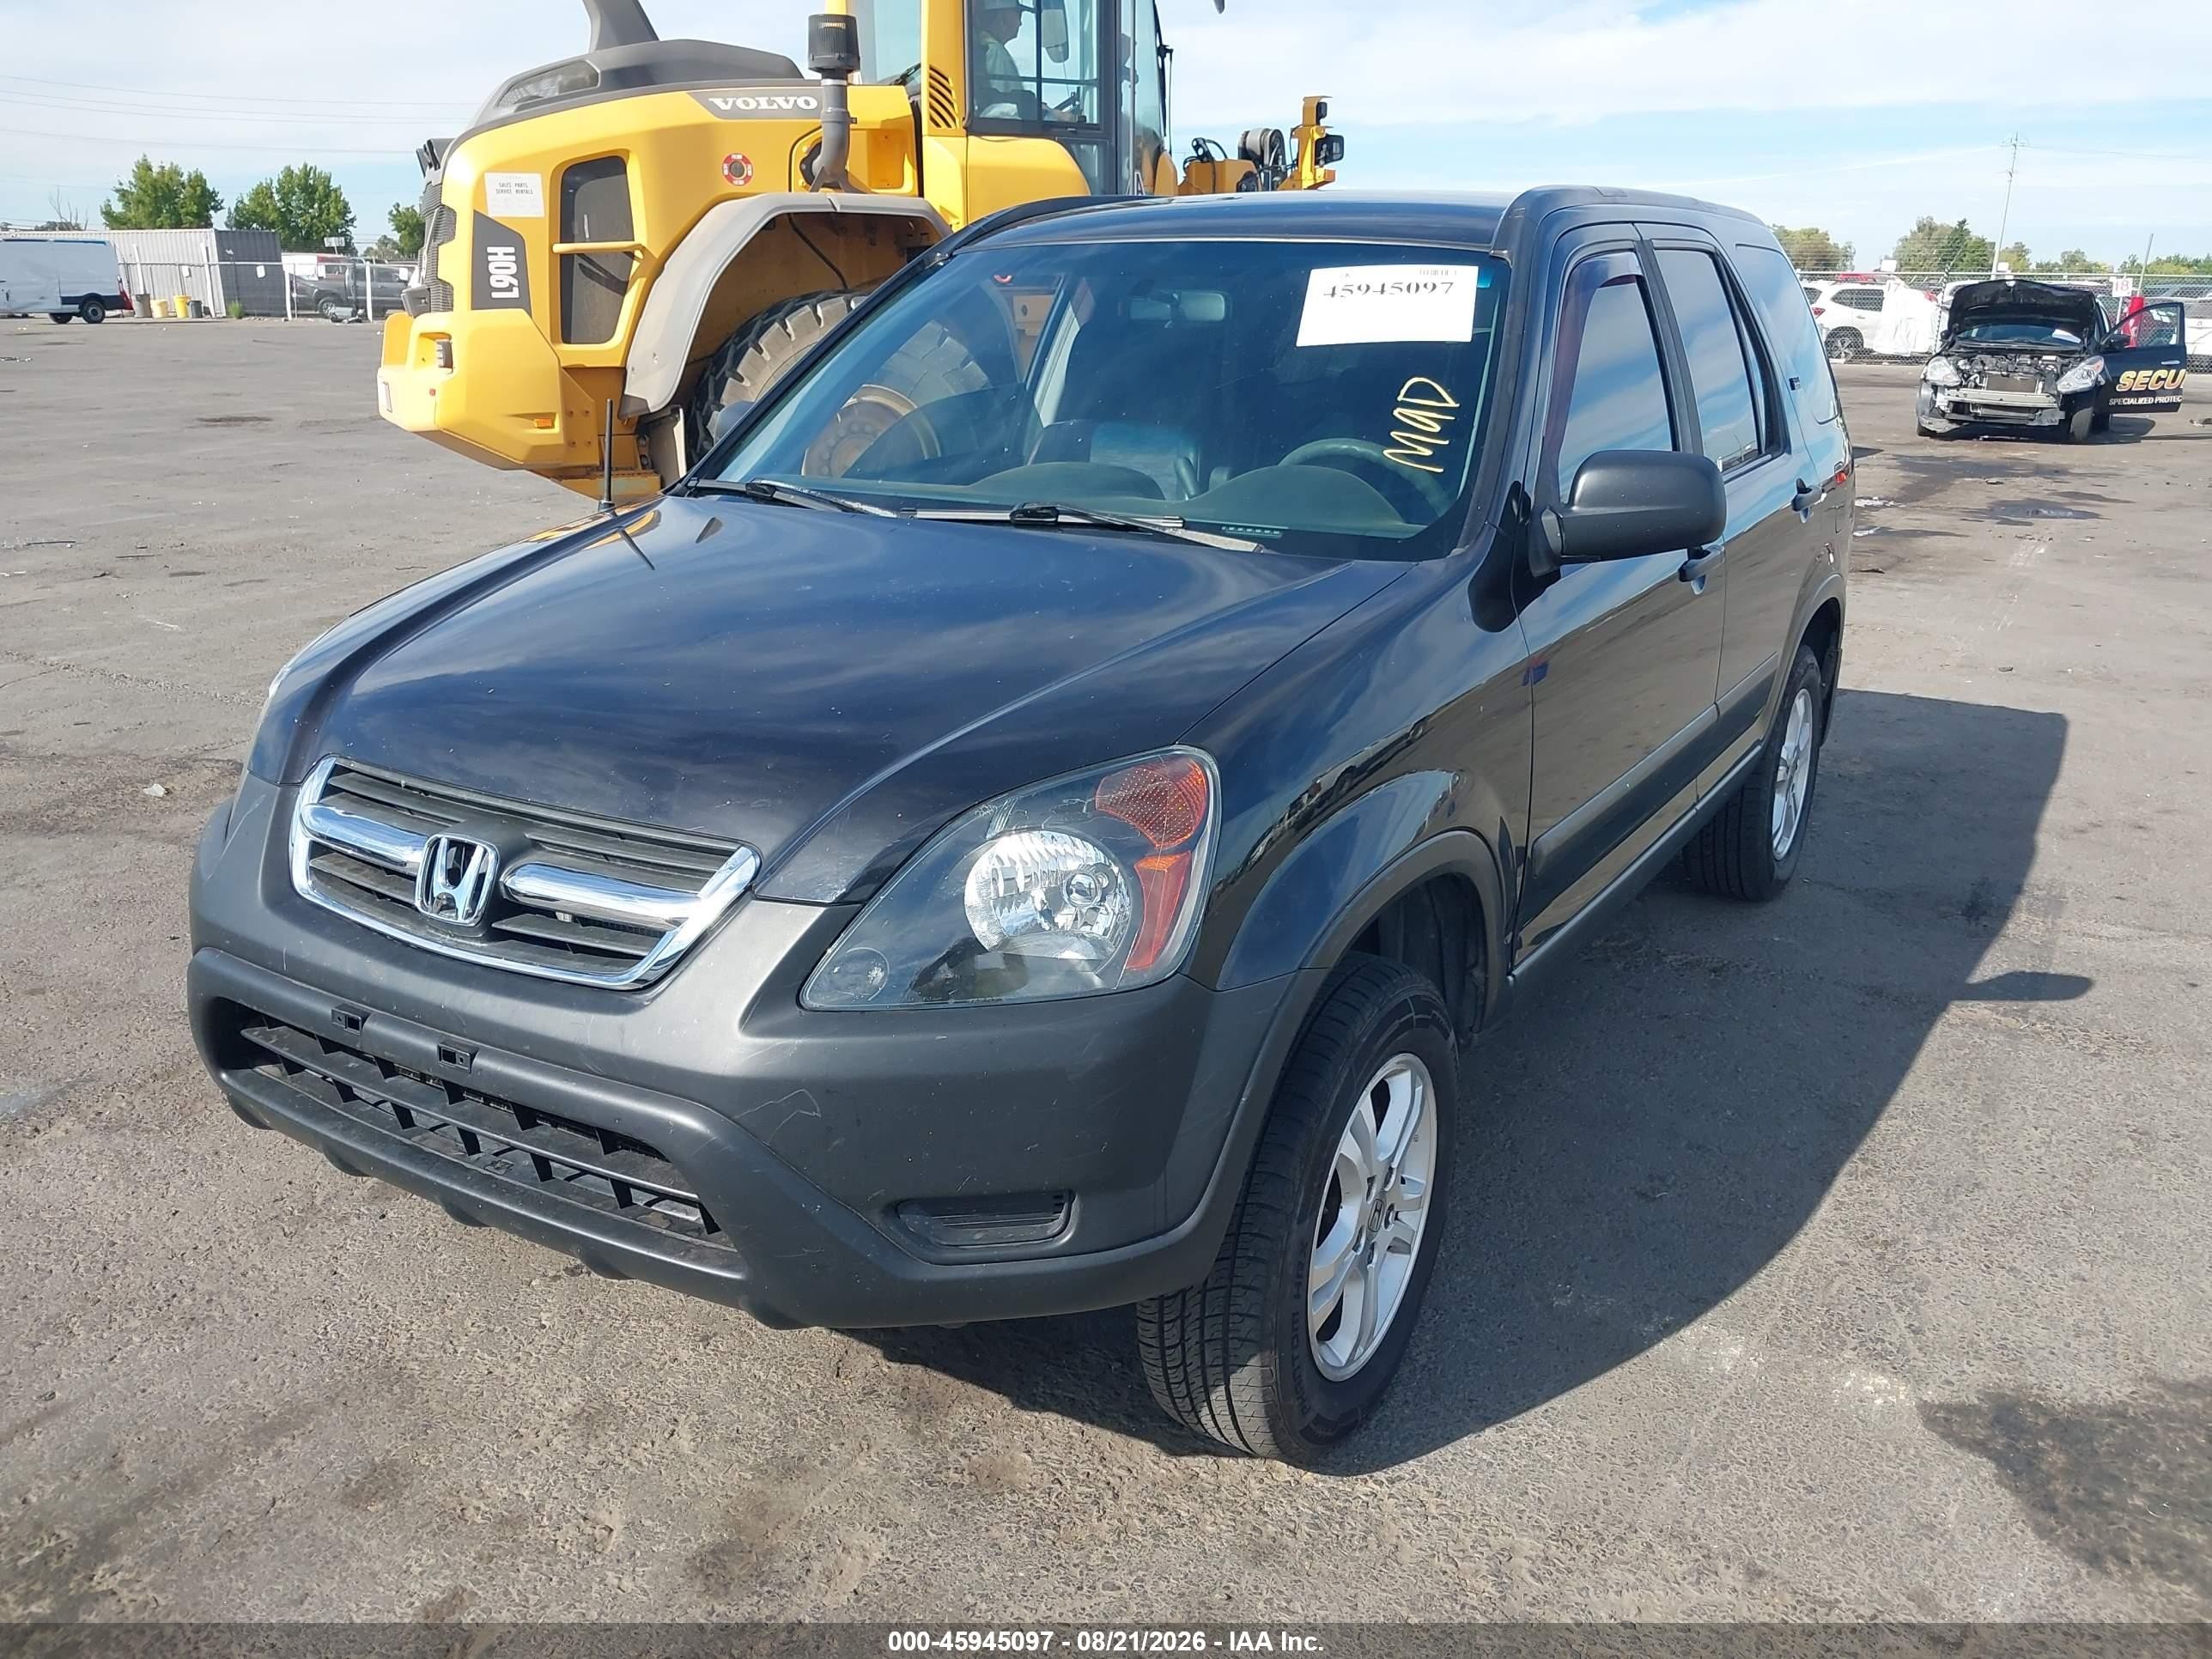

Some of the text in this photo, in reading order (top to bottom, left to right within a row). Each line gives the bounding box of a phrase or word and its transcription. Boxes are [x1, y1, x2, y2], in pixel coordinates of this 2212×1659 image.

[708, 95, 818, 110] VOLVO
[486, 246, 520, 298] L90H
[1323, 282, 1453, 298] 45945097
[2116, 369, 2185, 392] SECU
